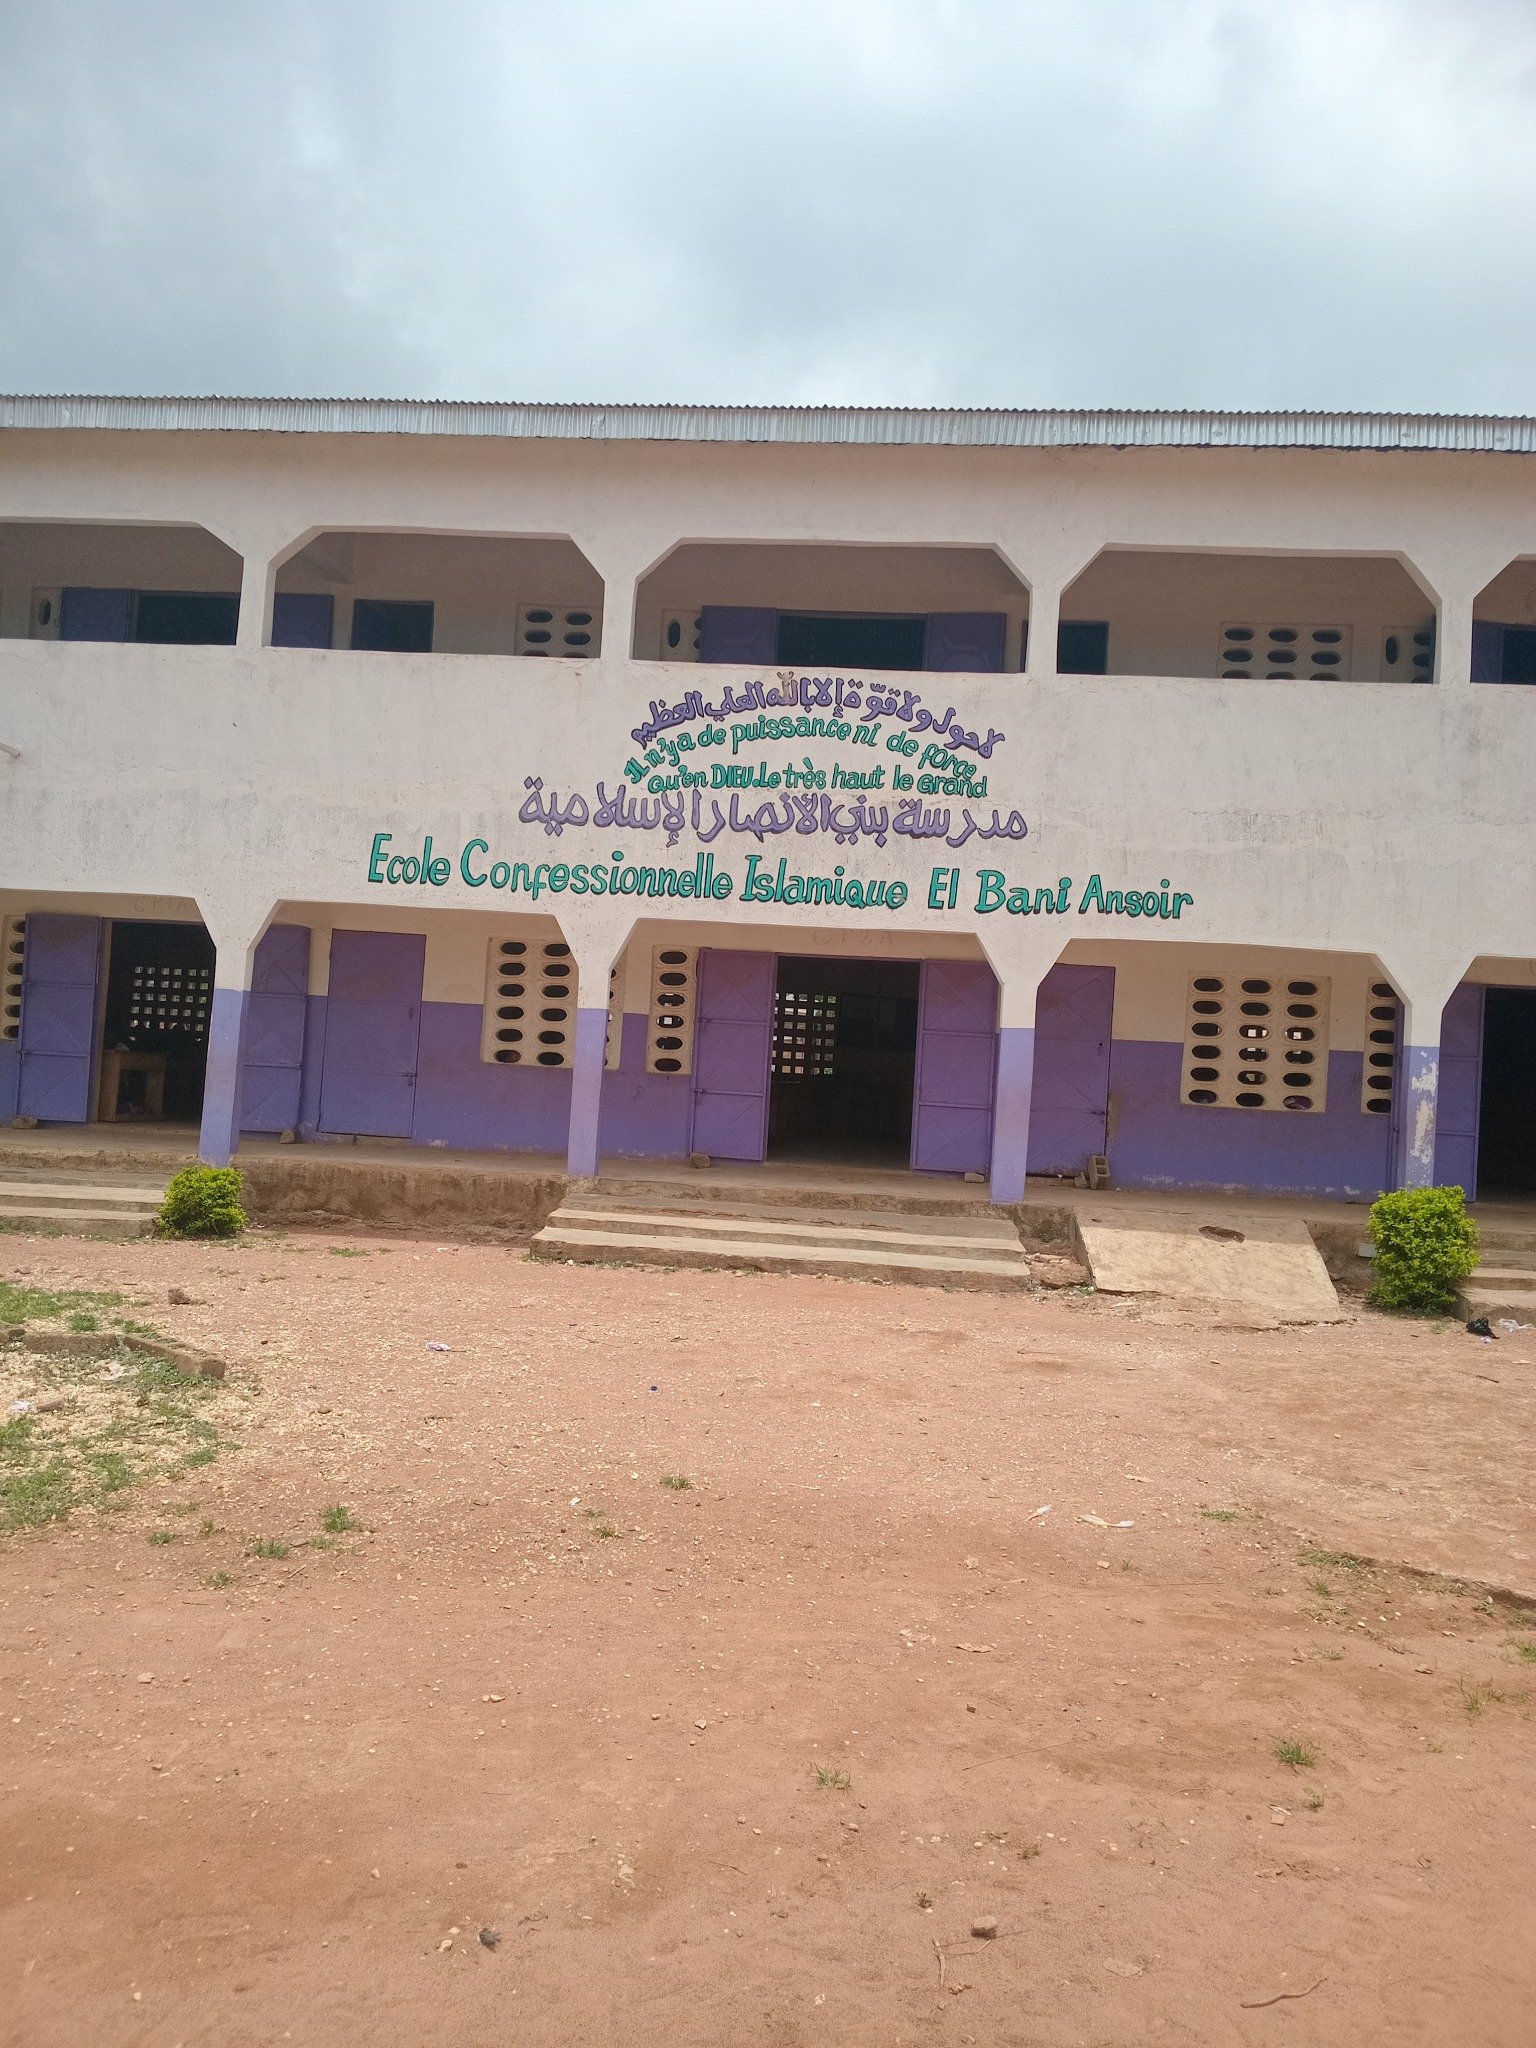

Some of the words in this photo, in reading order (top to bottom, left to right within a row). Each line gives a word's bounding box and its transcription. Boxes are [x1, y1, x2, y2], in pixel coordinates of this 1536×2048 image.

[697, 723, 727, 747] de
[730, 714, 852, 755] puissance
[852, 722, 882, 747] ni
[886, 731, 919, 757] de
[917, 743, 977, 780] force
[782, 757, 827, 789] très
[831, 763, 885, 790] haut
[892, 764, 914, 791] le
[518, 776, 702, 848] الإسلامية
[829, 793, 889, 848] بني
[892, 798, 1028, 848] مدرسة
[367, 833, 451, 887] Ecole
[459, 838, 734, 901] Confessionnelle
[927, 867, 960, 910] El
[974, 869, 1072, 916] Bani
[1078, 873, 1194, 919] Ansoir
